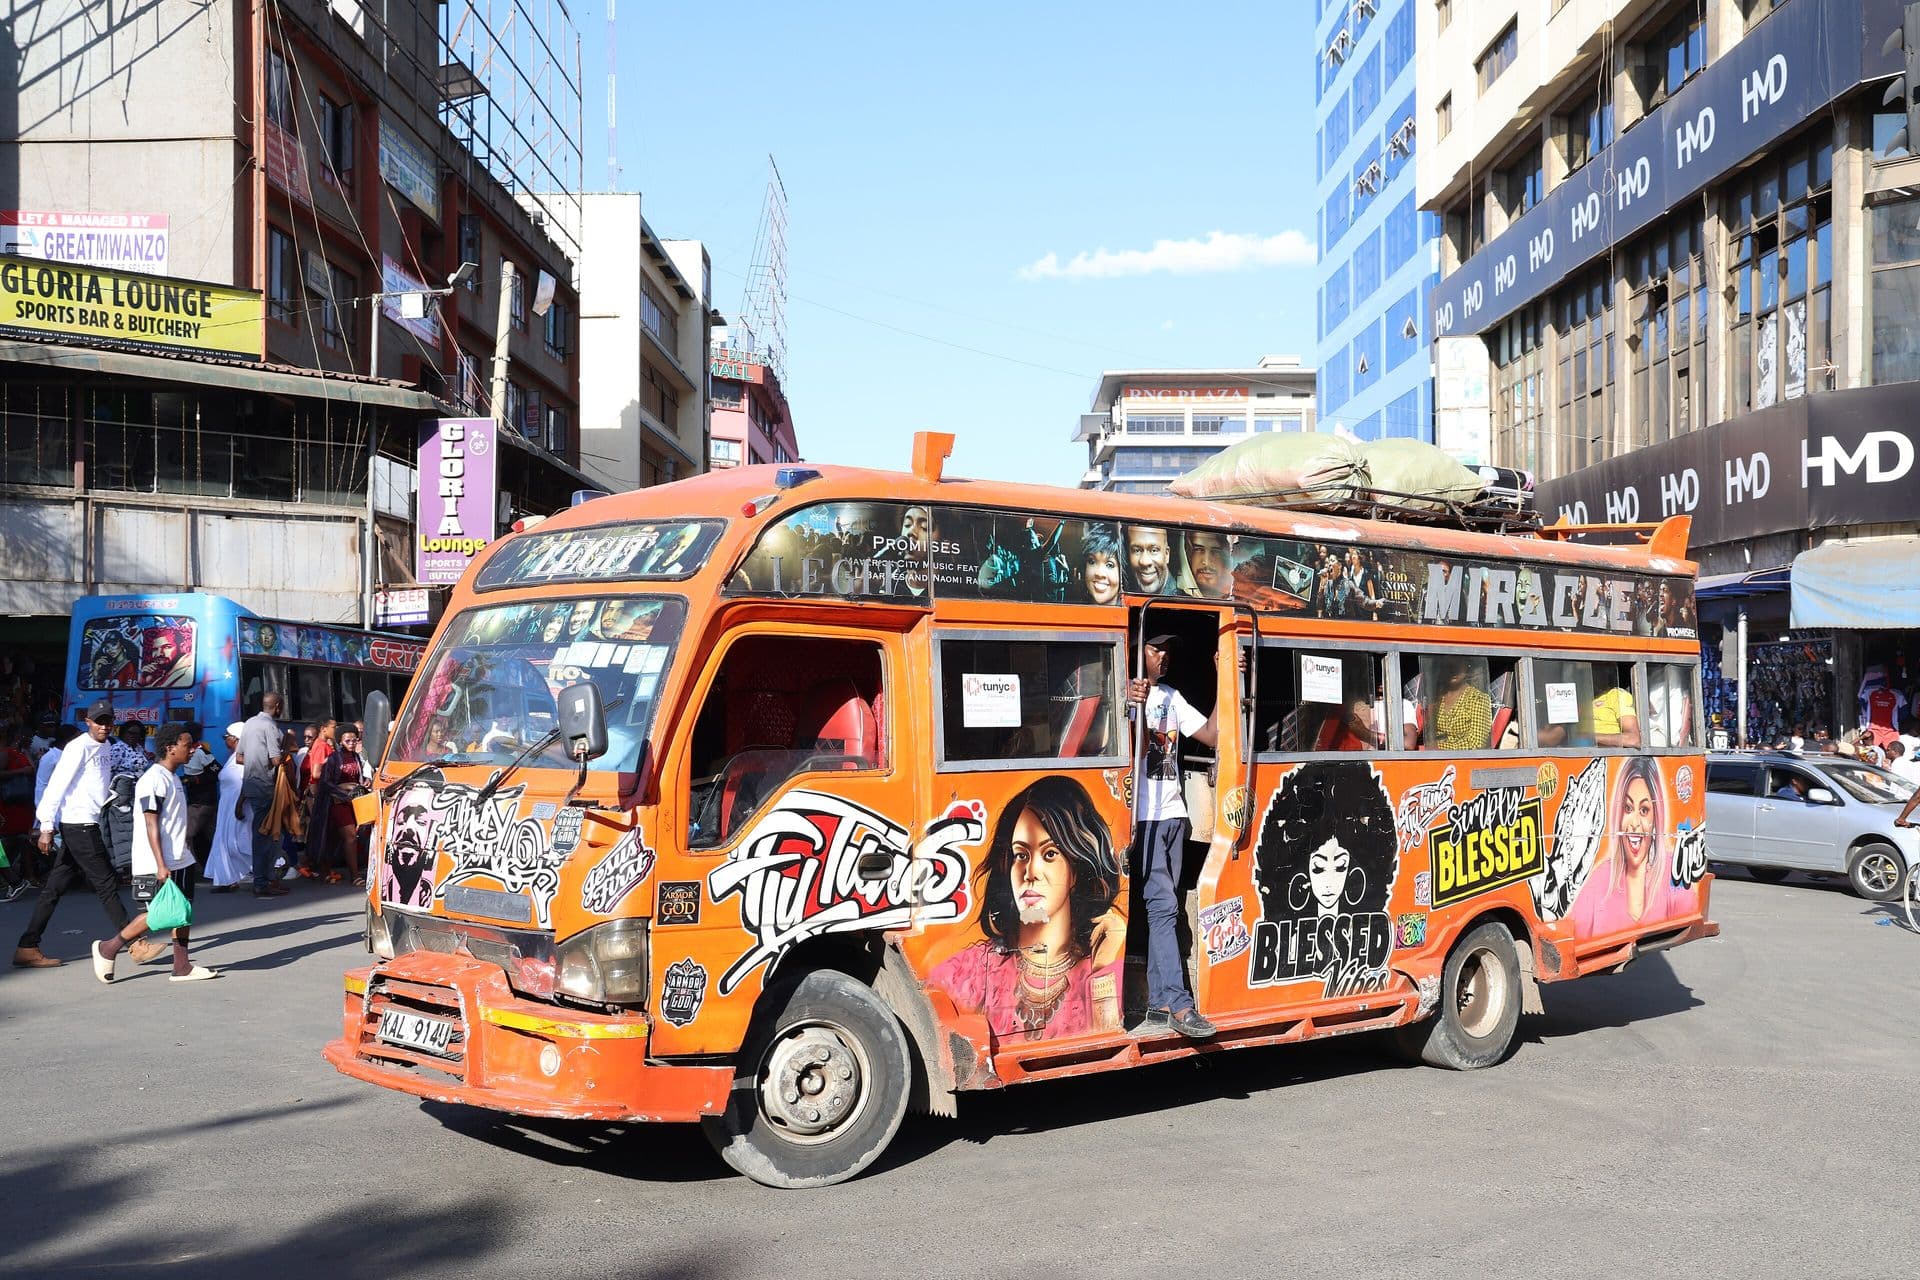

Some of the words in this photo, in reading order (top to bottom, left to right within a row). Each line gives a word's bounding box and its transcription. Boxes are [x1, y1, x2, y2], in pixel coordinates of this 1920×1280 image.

[1436, 297, 1453, 336] HMD
[1463, 279, 1482, 319] HMD
[1495, 254, 1516, 296] HMD
[1529, 228, 1554, 273] HMD
[1571, 192, 1599, 243] HMD
[1618, 157, 1650, 210] HMD
[1676, 106, 1715, 169] HMD
[1741, 54, 1788, 123] HMD
[19, 213, 44, 224] LET
[61, 214, 128, 226] MANAGED
[131, 216, 150, 227] BY
[44, 232, 165, 261] GREATMWANZO
[1, 263, 103, 305] GLORIA
[112, 277, 212, 319] LOUNGE
[16, 300, 75, 324] SPORTS
[79, 309, 109, 329] BAR
[114, 313, 125, 330] &
[128, 315, 201, 340] BUTCHERY
[1802, 431, 1914, 488] HMD
[437, 423, 464, 536] GLORIA
[1606, 486, 1639, 524] HMD
[1661, 468, 1699, 517] HMD
[1726, 452, 1771, 505] HMD
[420, 534, 486, 557] Lounge
[899, 560, 919, 569] CITY
[923, 562, 954, 571] MUSIC
[909, 574, 928, 582] AND
[933, 574, 962, 584] NAOMI
[1386, 571, 1408, 582] GOD
[376, 590, 425, 604] CYBER
[1424, 562, 1635, 631] MIRACLE
[1449, 786, 1520, 846] simply
[584, 836, 641, 907] Jesus
[1438, 815, 1537, 893] BLESSED
[593, 851, 652, 911] First
[665, 890, 694, 900] ARMOR
[662, 902, 696, 916] GOD
[1252, 913, 1391, 983] BLESSED
[670, 974, 701, 989] ARMOR
[1321, 960, 1388, 998] Vibes
[671, 995, 692, 1009] GOD
[379, 1011, 406, 1040] KAL
[414, 1019, 451, 1048] 914U
